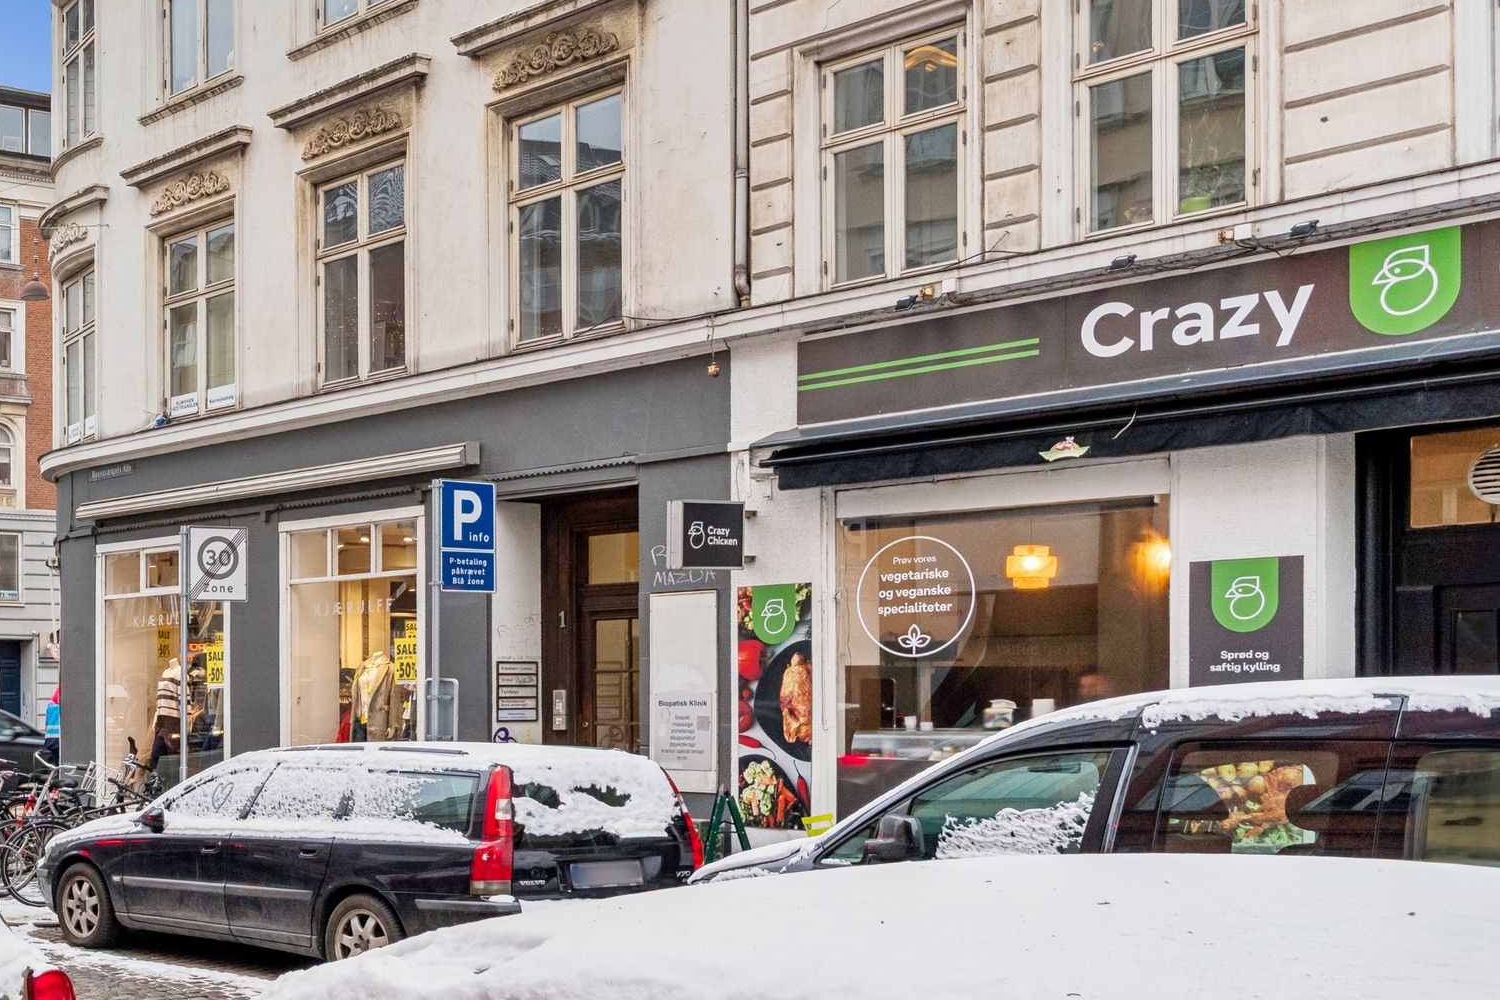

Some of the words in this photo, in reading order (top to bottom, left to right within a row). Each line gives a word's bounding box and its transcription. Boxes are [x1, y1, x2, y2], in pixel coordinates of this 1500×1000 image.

[1080, 283, 1315, 358] Crazy
[453, 490, 482, 541] P
[469, 531, 490, 543] info
[707, 526, 731, 537] Crazy
[707, 536, 739, 546] Chicken
[205, 549, 232, 567] 30
[449, 558, 487, 567] P-betaling
[892, 556, 913, 565] Prøv
[913, 554, 937, 564] vores
[451, 567, 486, 576] påkrævet
[880, 567, 950, 583] vegetariske
[452, 577, 465, 585] Blå
[203, 583, 234, 594] Zone
[878, 590, 894, 601] og
[895, 584, 952, 600] veganske
[877, 602, 953, 617] specialiteter
[558, 610, 566, 628] 1
[406, 622, 417, 631] SAL
[396, 643, 417, 656] SALE
[208, 651, 224, 662] SALE
[1220, 650, 1253, 661] Sprød
[1255, 651, 1270, 661] og
[1210, 662, 1241, 674] saftig
[1242, 661, 1281, 674] kylling
[658, 700, 688, 708] Biopatisk
[689, 699, 708, 707] Klinik
[675, 870, 692, 878] V70
